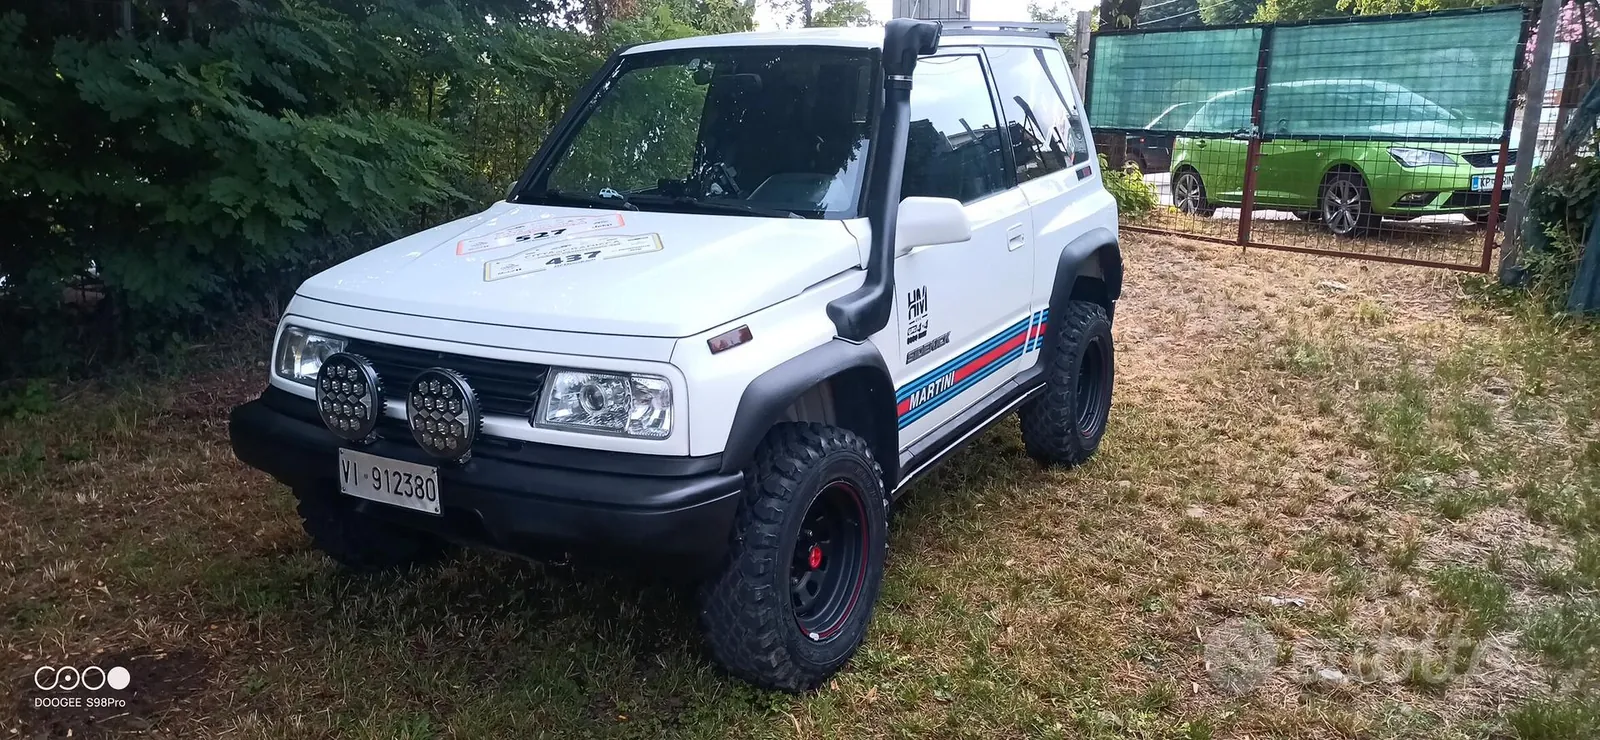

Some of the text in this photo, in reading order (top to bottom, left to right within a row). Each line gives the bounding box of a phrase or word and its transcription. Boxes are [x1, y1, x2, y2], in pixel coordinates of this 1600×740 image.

[516, 228, 567, 243] 527
[545, 250, 602, 266] 437
[909, 371, 956, 411] MARTINI
[342, 460, 436, 502] VI 912380
